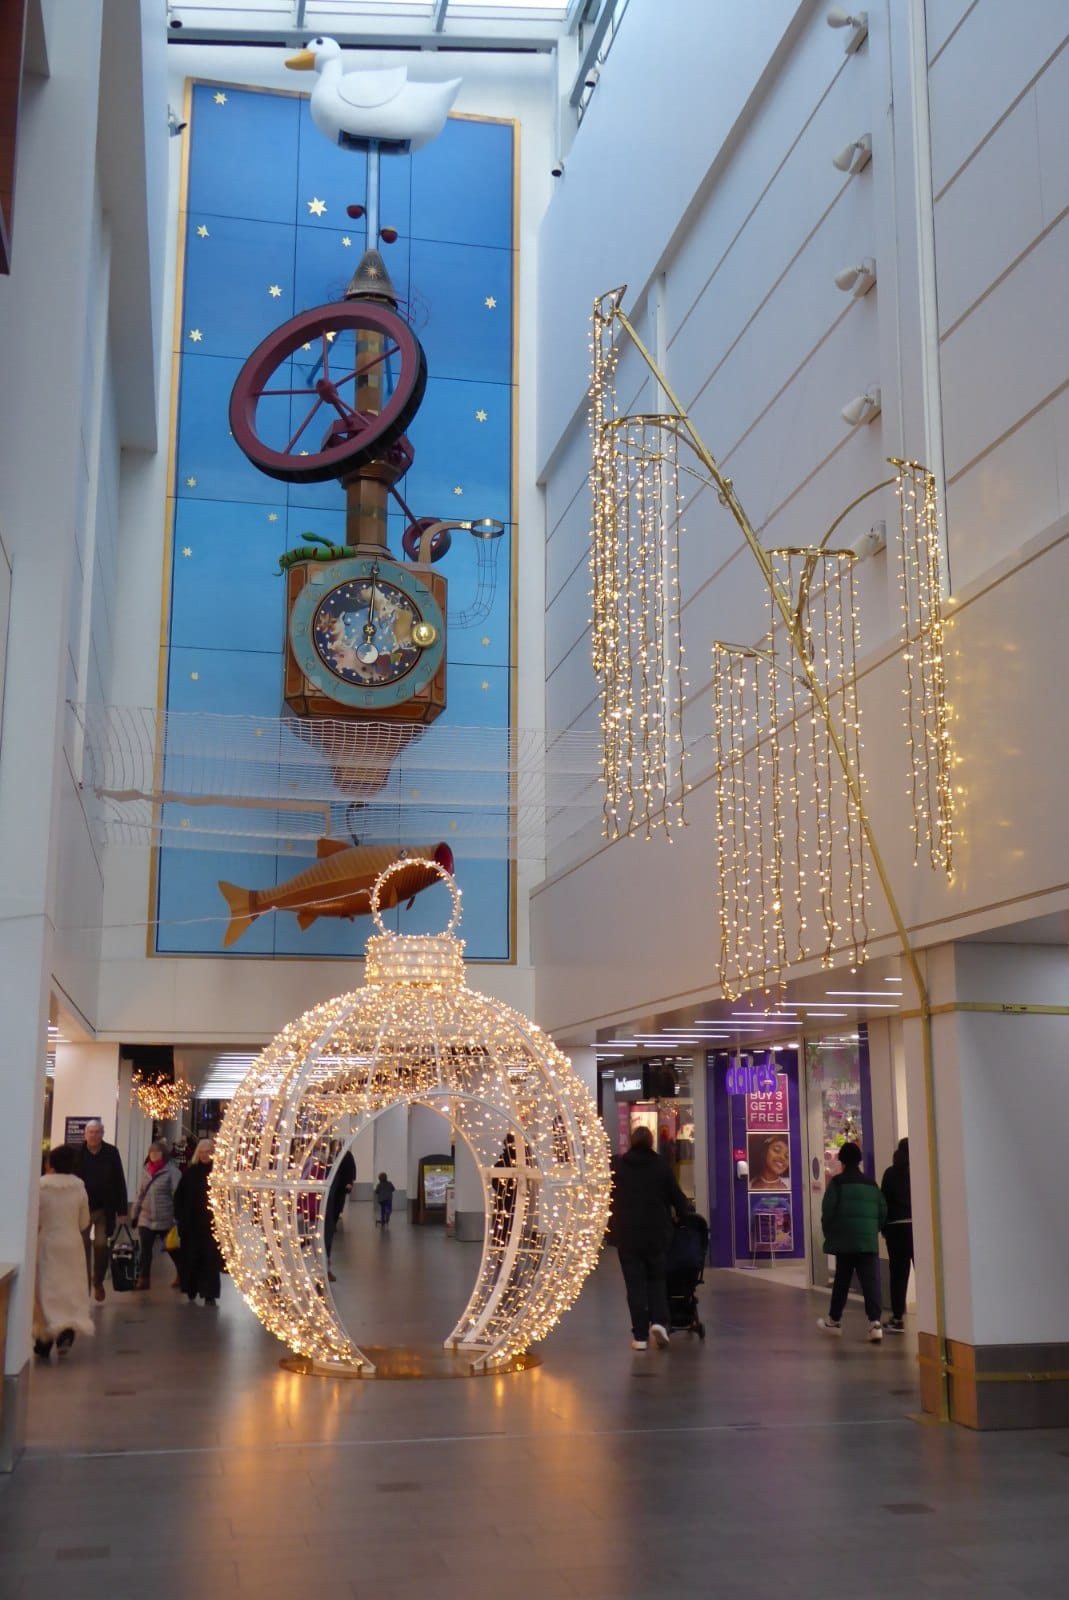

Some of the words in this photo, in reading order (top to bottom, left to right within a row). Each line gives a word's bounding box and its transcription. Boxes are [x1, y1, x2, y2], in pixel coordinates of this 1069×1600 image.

[750, 1091, 773, 1100] BUY
[775, 1091, 783, 1101] 3
[750, 1101, 774, 1111] GET
[775, 1101, 783, 1111] 3
[750, 1112, 784, 1123] FREE
